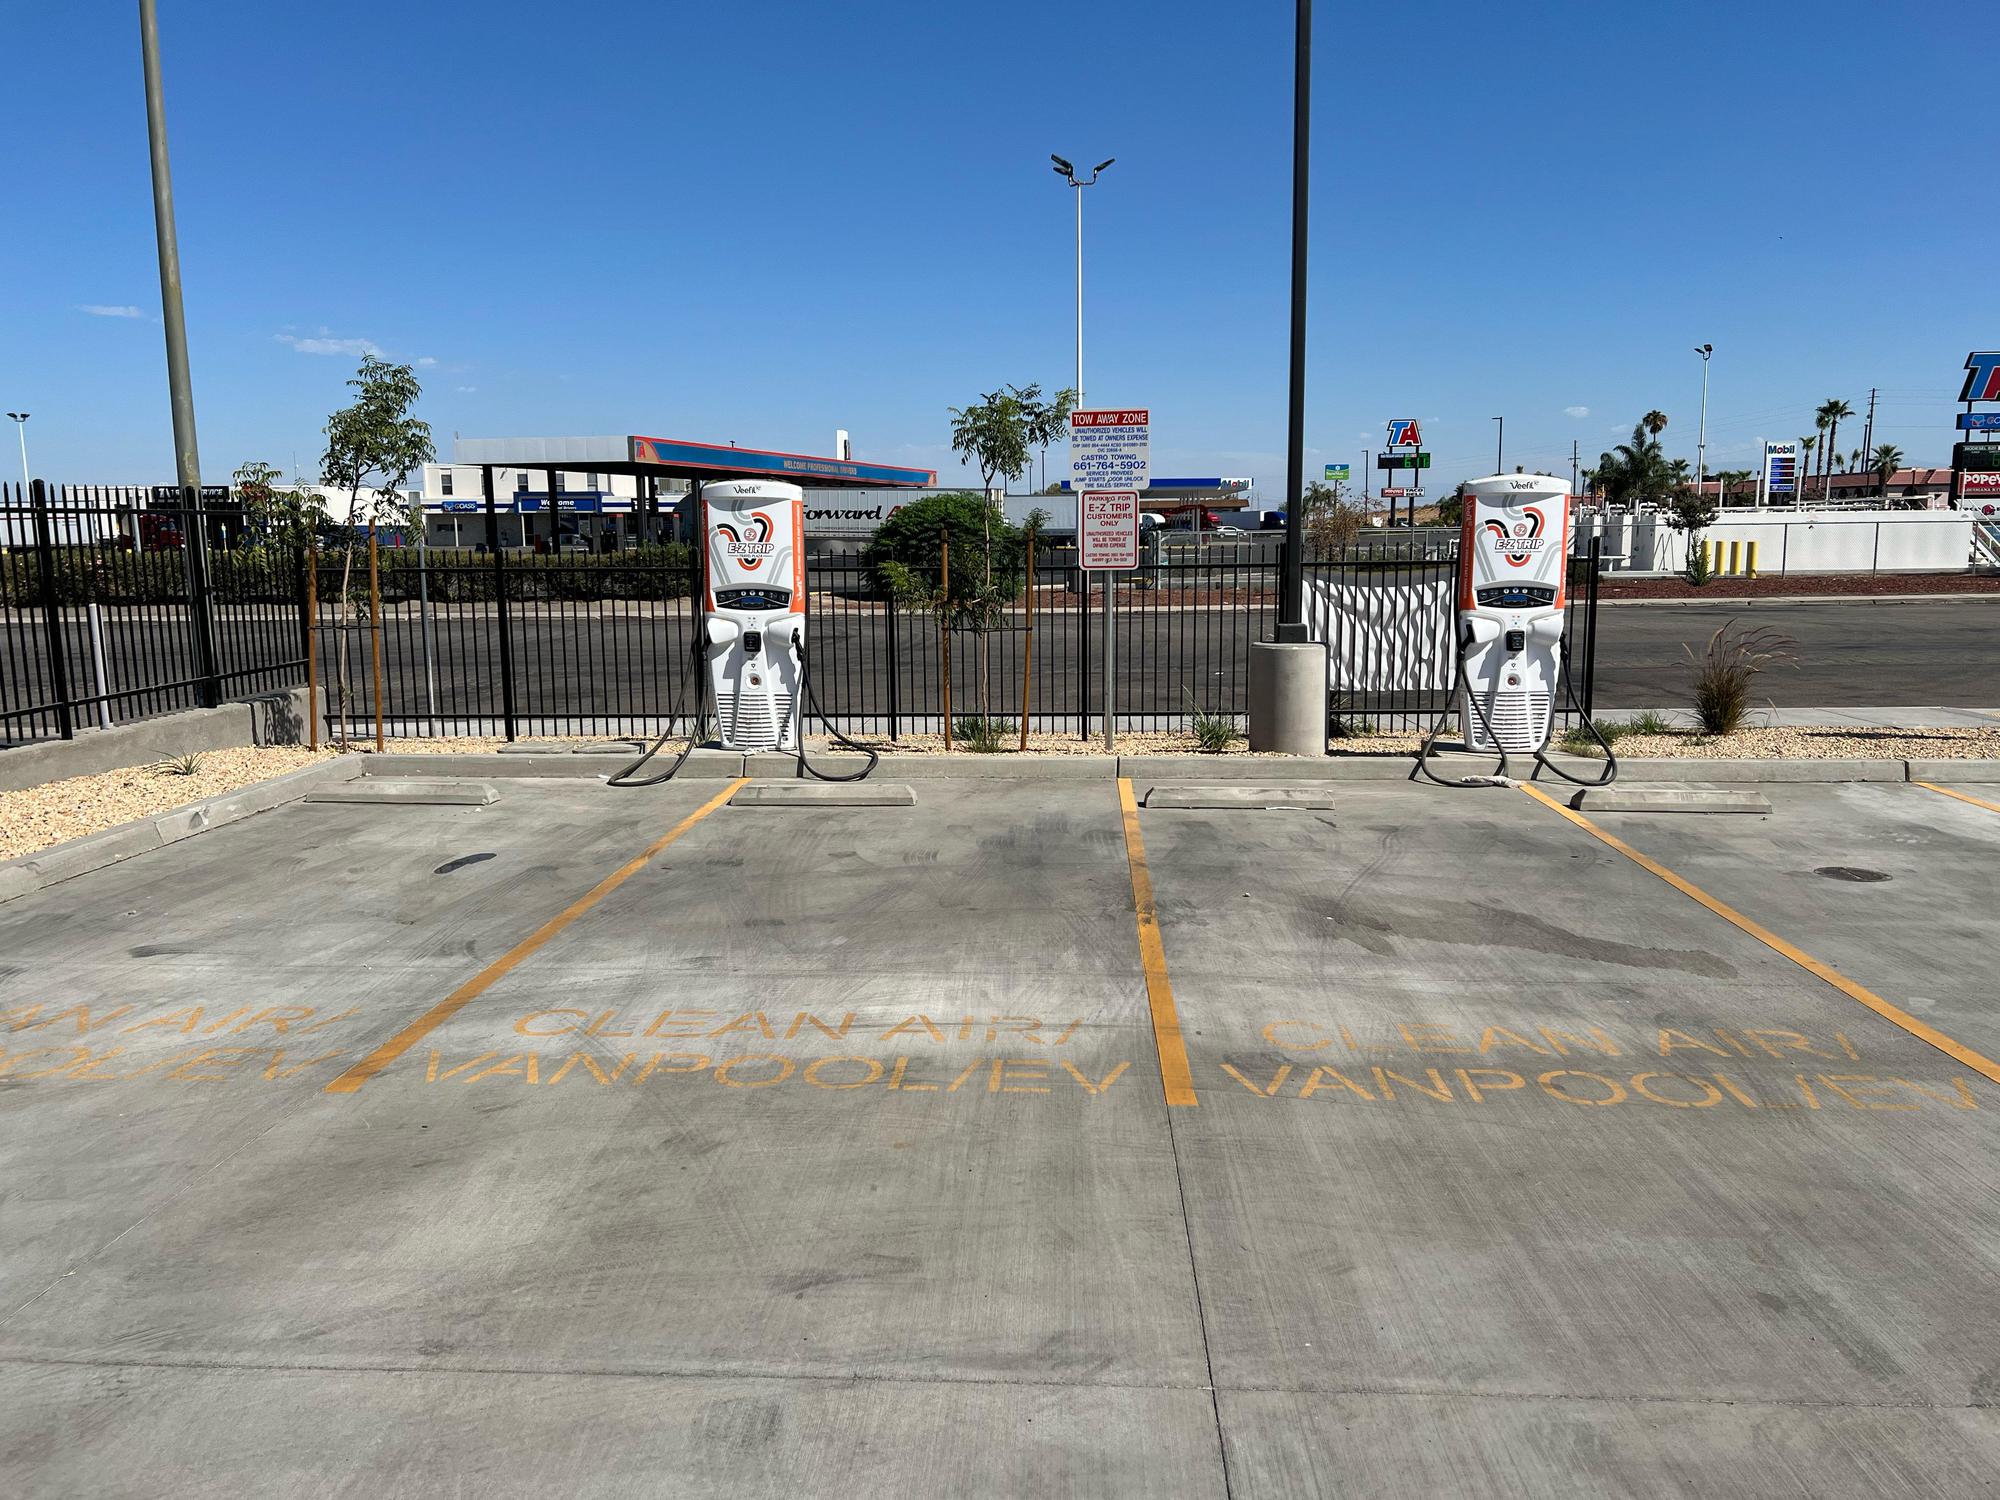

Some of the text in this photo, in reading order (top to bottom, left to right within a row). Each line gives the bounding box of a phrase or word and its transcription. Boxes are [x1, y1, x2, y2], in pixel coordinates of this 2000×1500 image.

[1073, 412, 1147, 425] TOW AWAY ZONE
[1388, 420, 1421, 447] TA
[1768, 445, 1795, 454] Mobil
[784, 460, 807, 470] WELCOME
[807, 462, 838, 473] PROFESSIONAL
[1073, 461, 1146, 470] 661-764-5902
[733, 485, 756, 494] Veefil
[1221, 480, 1250, 489] Mobil
[1509, 481, 1534, 489] Veefil
[1088, 503, 1131, 512] E-Z TRIP
[727, 542, 775, 554] E-Z TRIP
[1495, 538, 1545, 550] E-Z TRIP
[512, 1009, 856, 1040] CLEAN
[1262, 1020, 1622, 1056] CLEAN
[424, 1049, 1132, 1095] VANPOOL/EV
[1219, 1063, 1980, 1110] VANPOOL/EV
